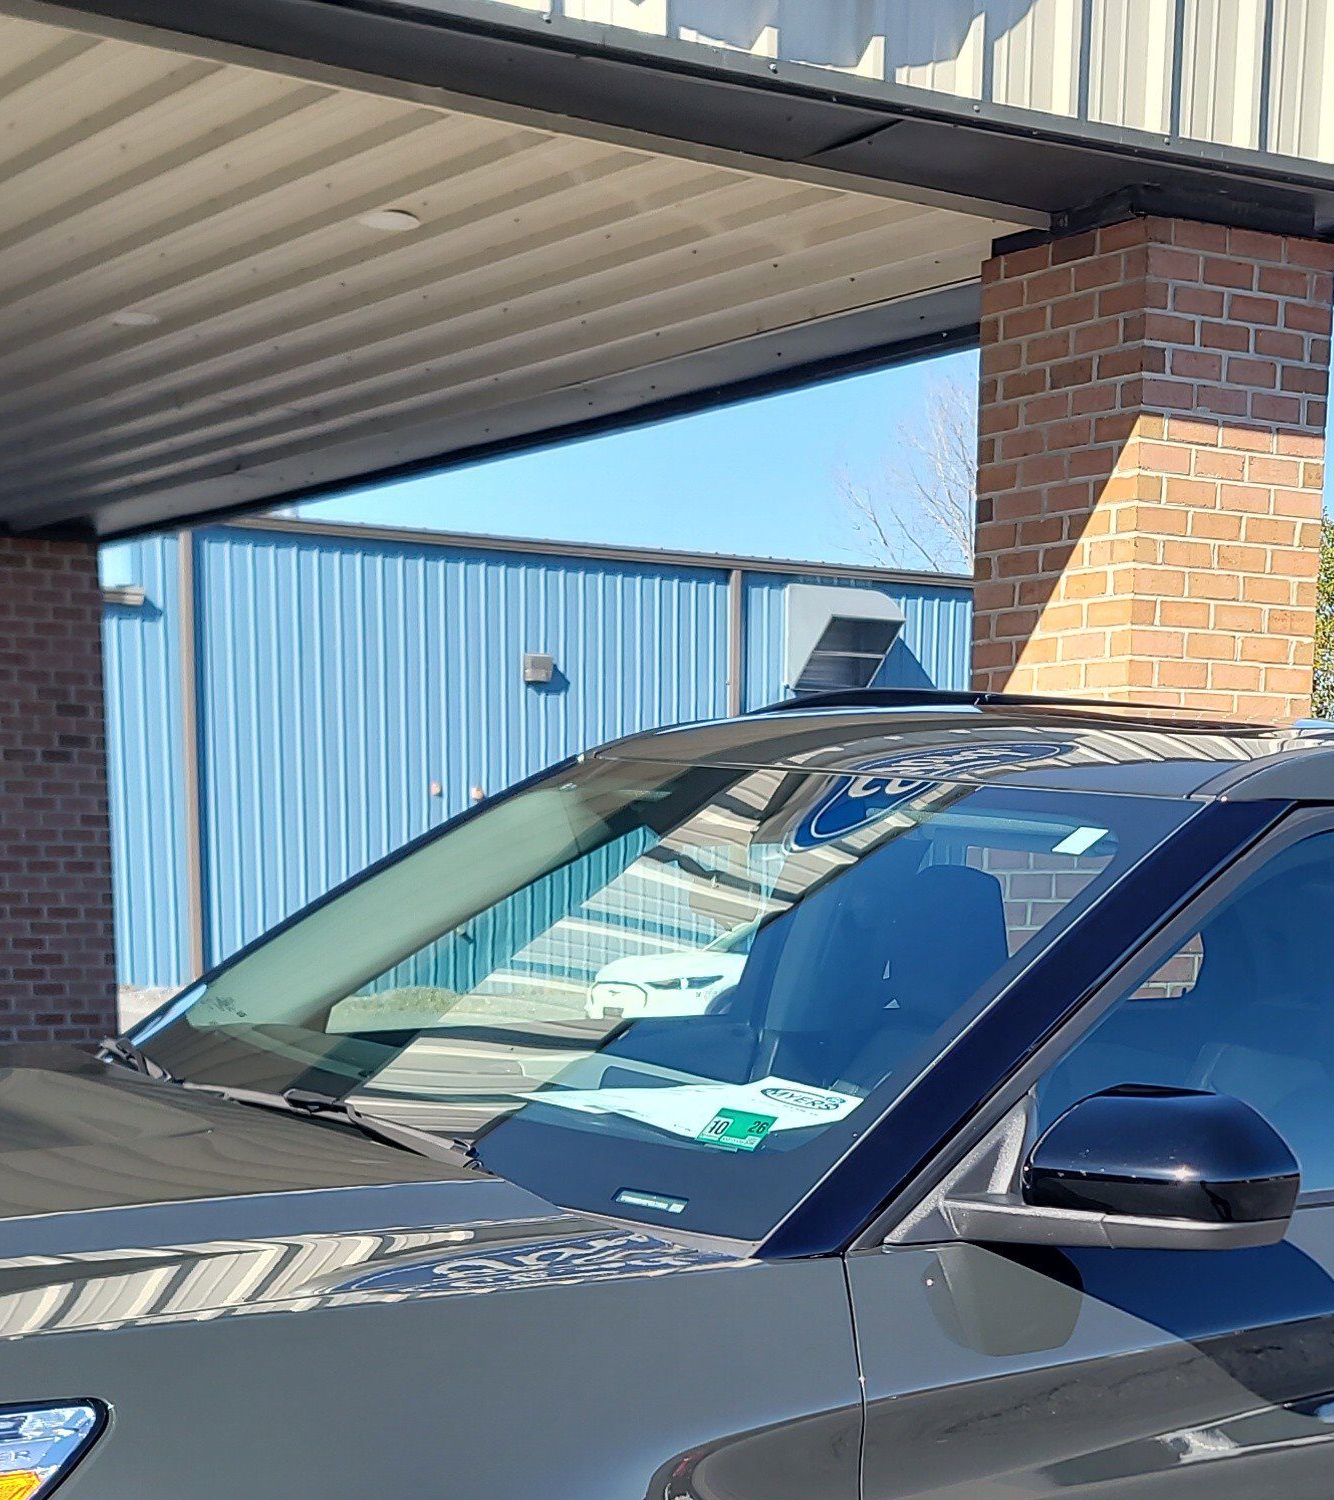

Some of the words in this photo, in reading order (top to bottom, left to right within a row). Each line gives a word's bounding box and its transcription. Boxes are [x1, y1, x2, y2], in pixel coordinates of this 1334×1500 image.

[768, 1088, 840, 1110] MYERS
[708, 1119, 730, 1135] 10
[748, 1120, 769, 1135] 26
